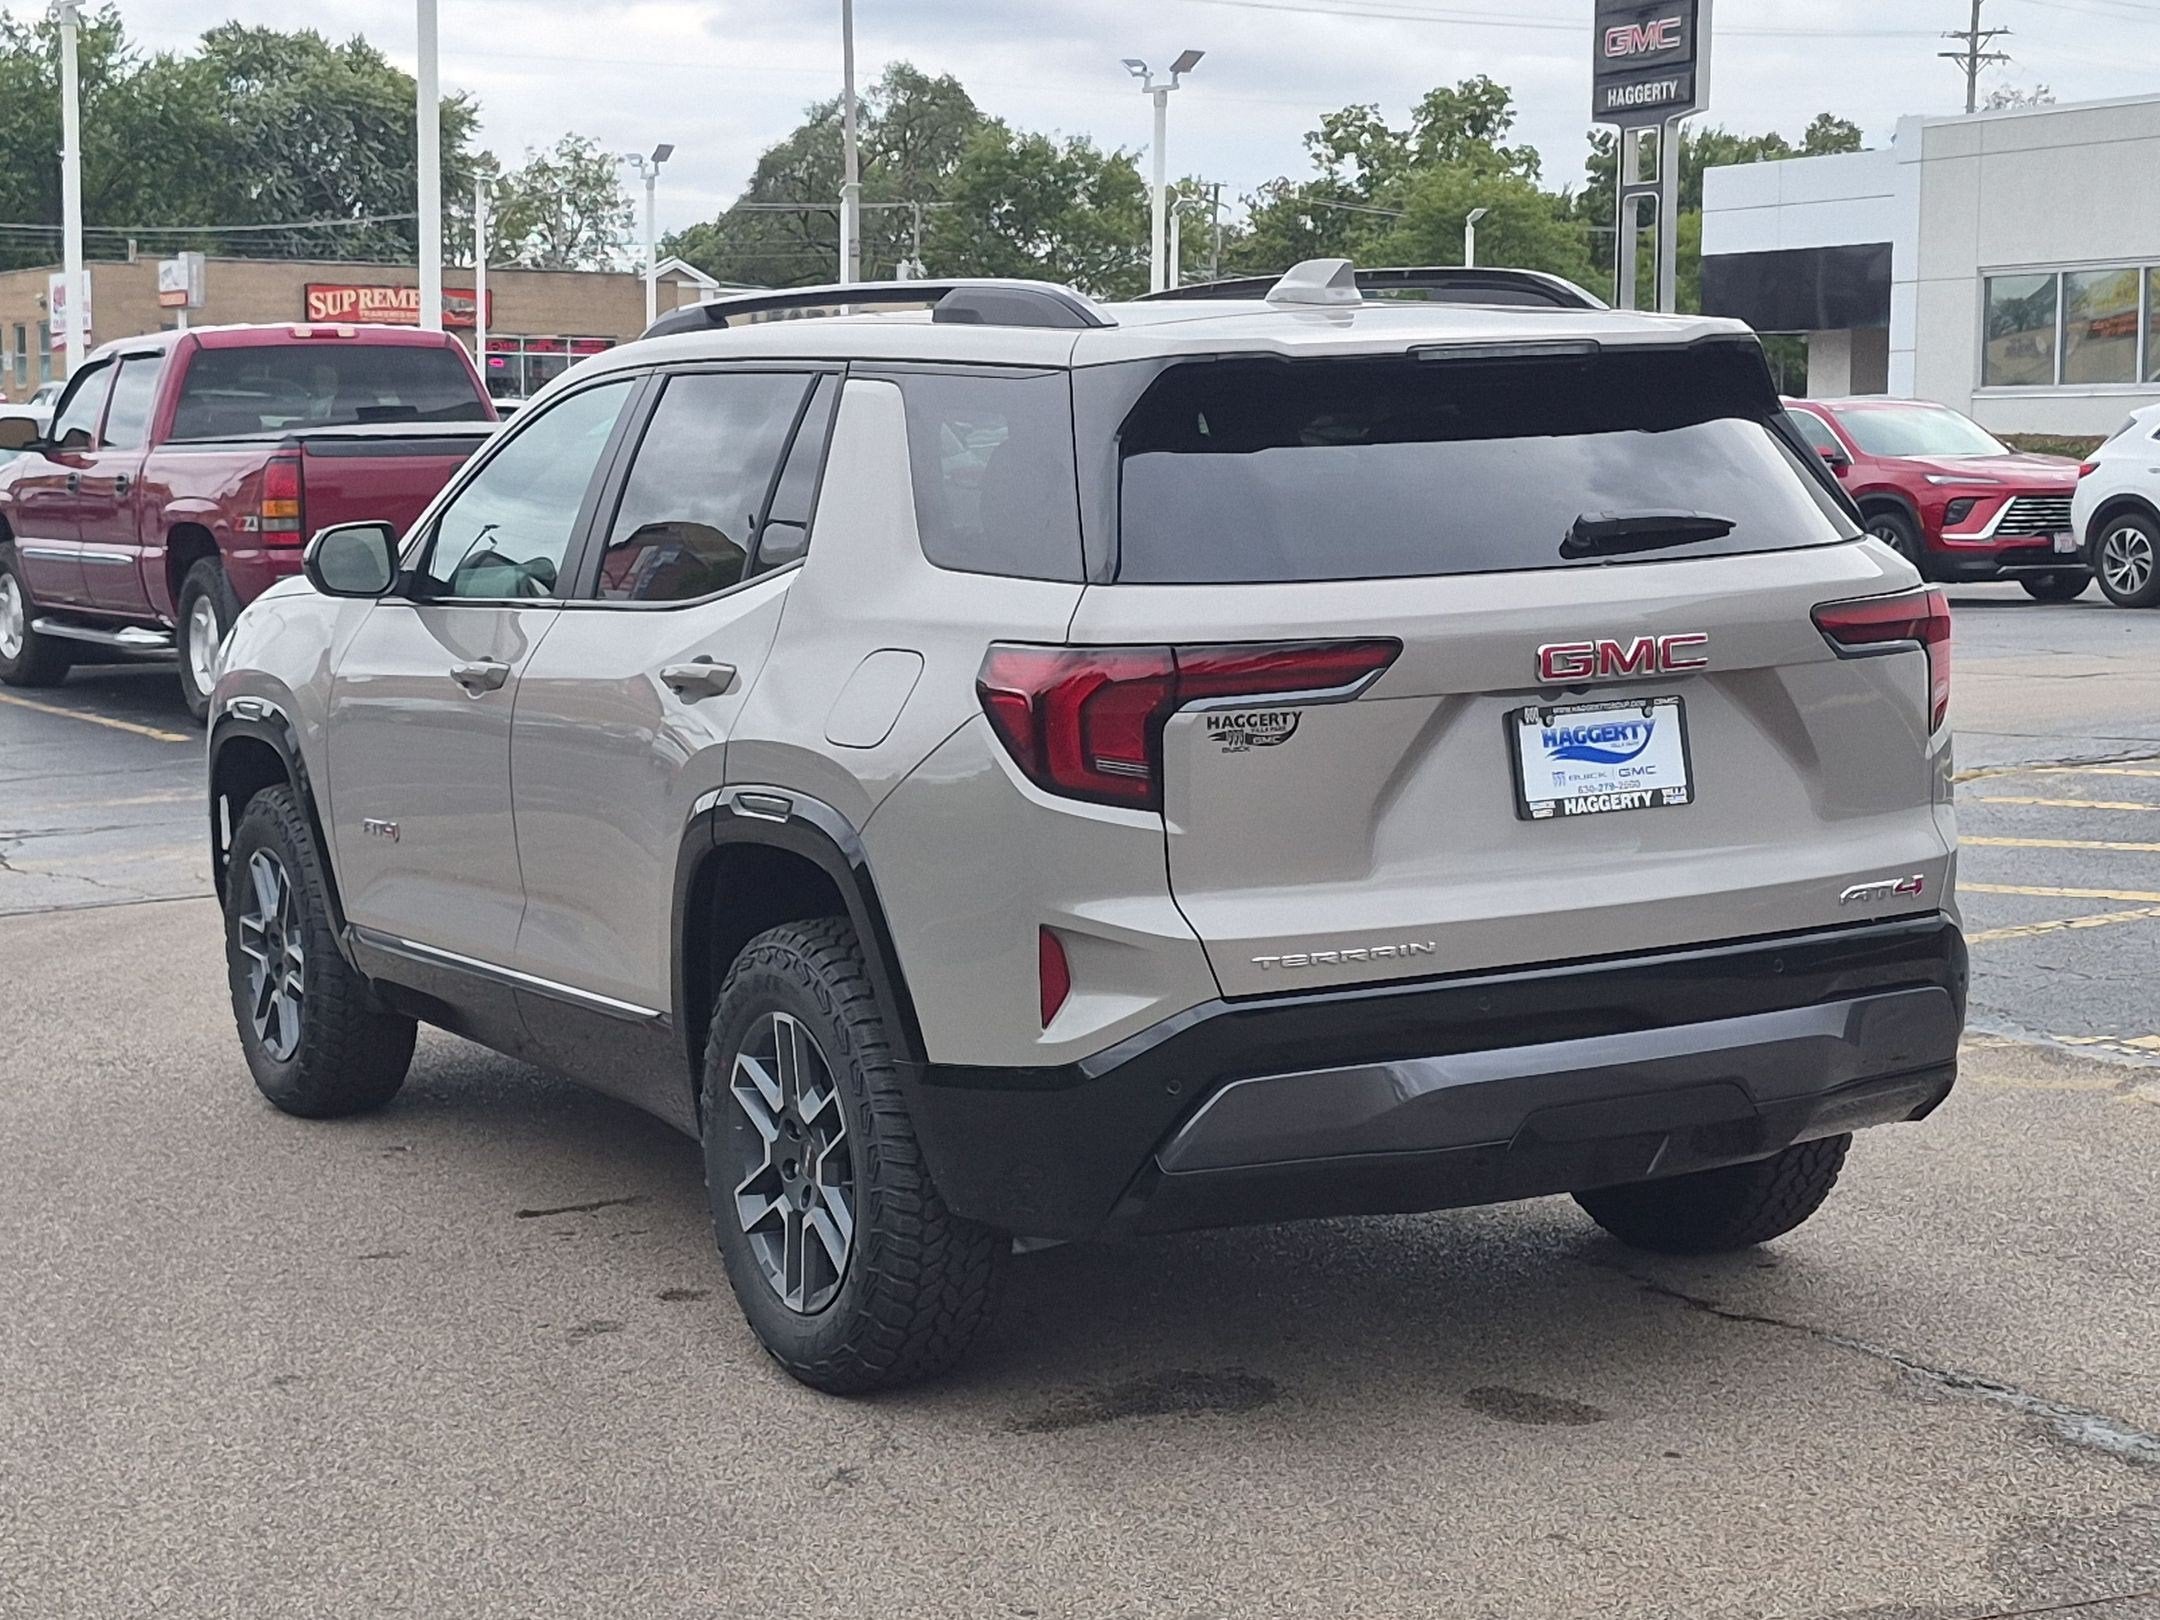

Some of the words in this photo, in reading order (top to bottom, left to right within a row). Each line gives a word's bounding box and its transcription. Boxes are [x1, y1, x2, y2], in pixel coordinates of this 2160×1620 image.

[1605, 17, 1681, 57] GMC
[1607, 80, 1678, 107] HAGGERTY
[309, 288, 420, 320] SUPREME
[1537, 632, 1708, 682] GMC
[1207, 711, 1302, 730] HAGGERTY
[1541, 719, 1656, 748] HAGGERTY
[1618, 765, 1656, 778] GMC
[1564, 791, 1653, 816] HAGGERTY
[1839, 874, 1924, 904] AT4
[1251, 941, 1436, 970] TERRAIN
